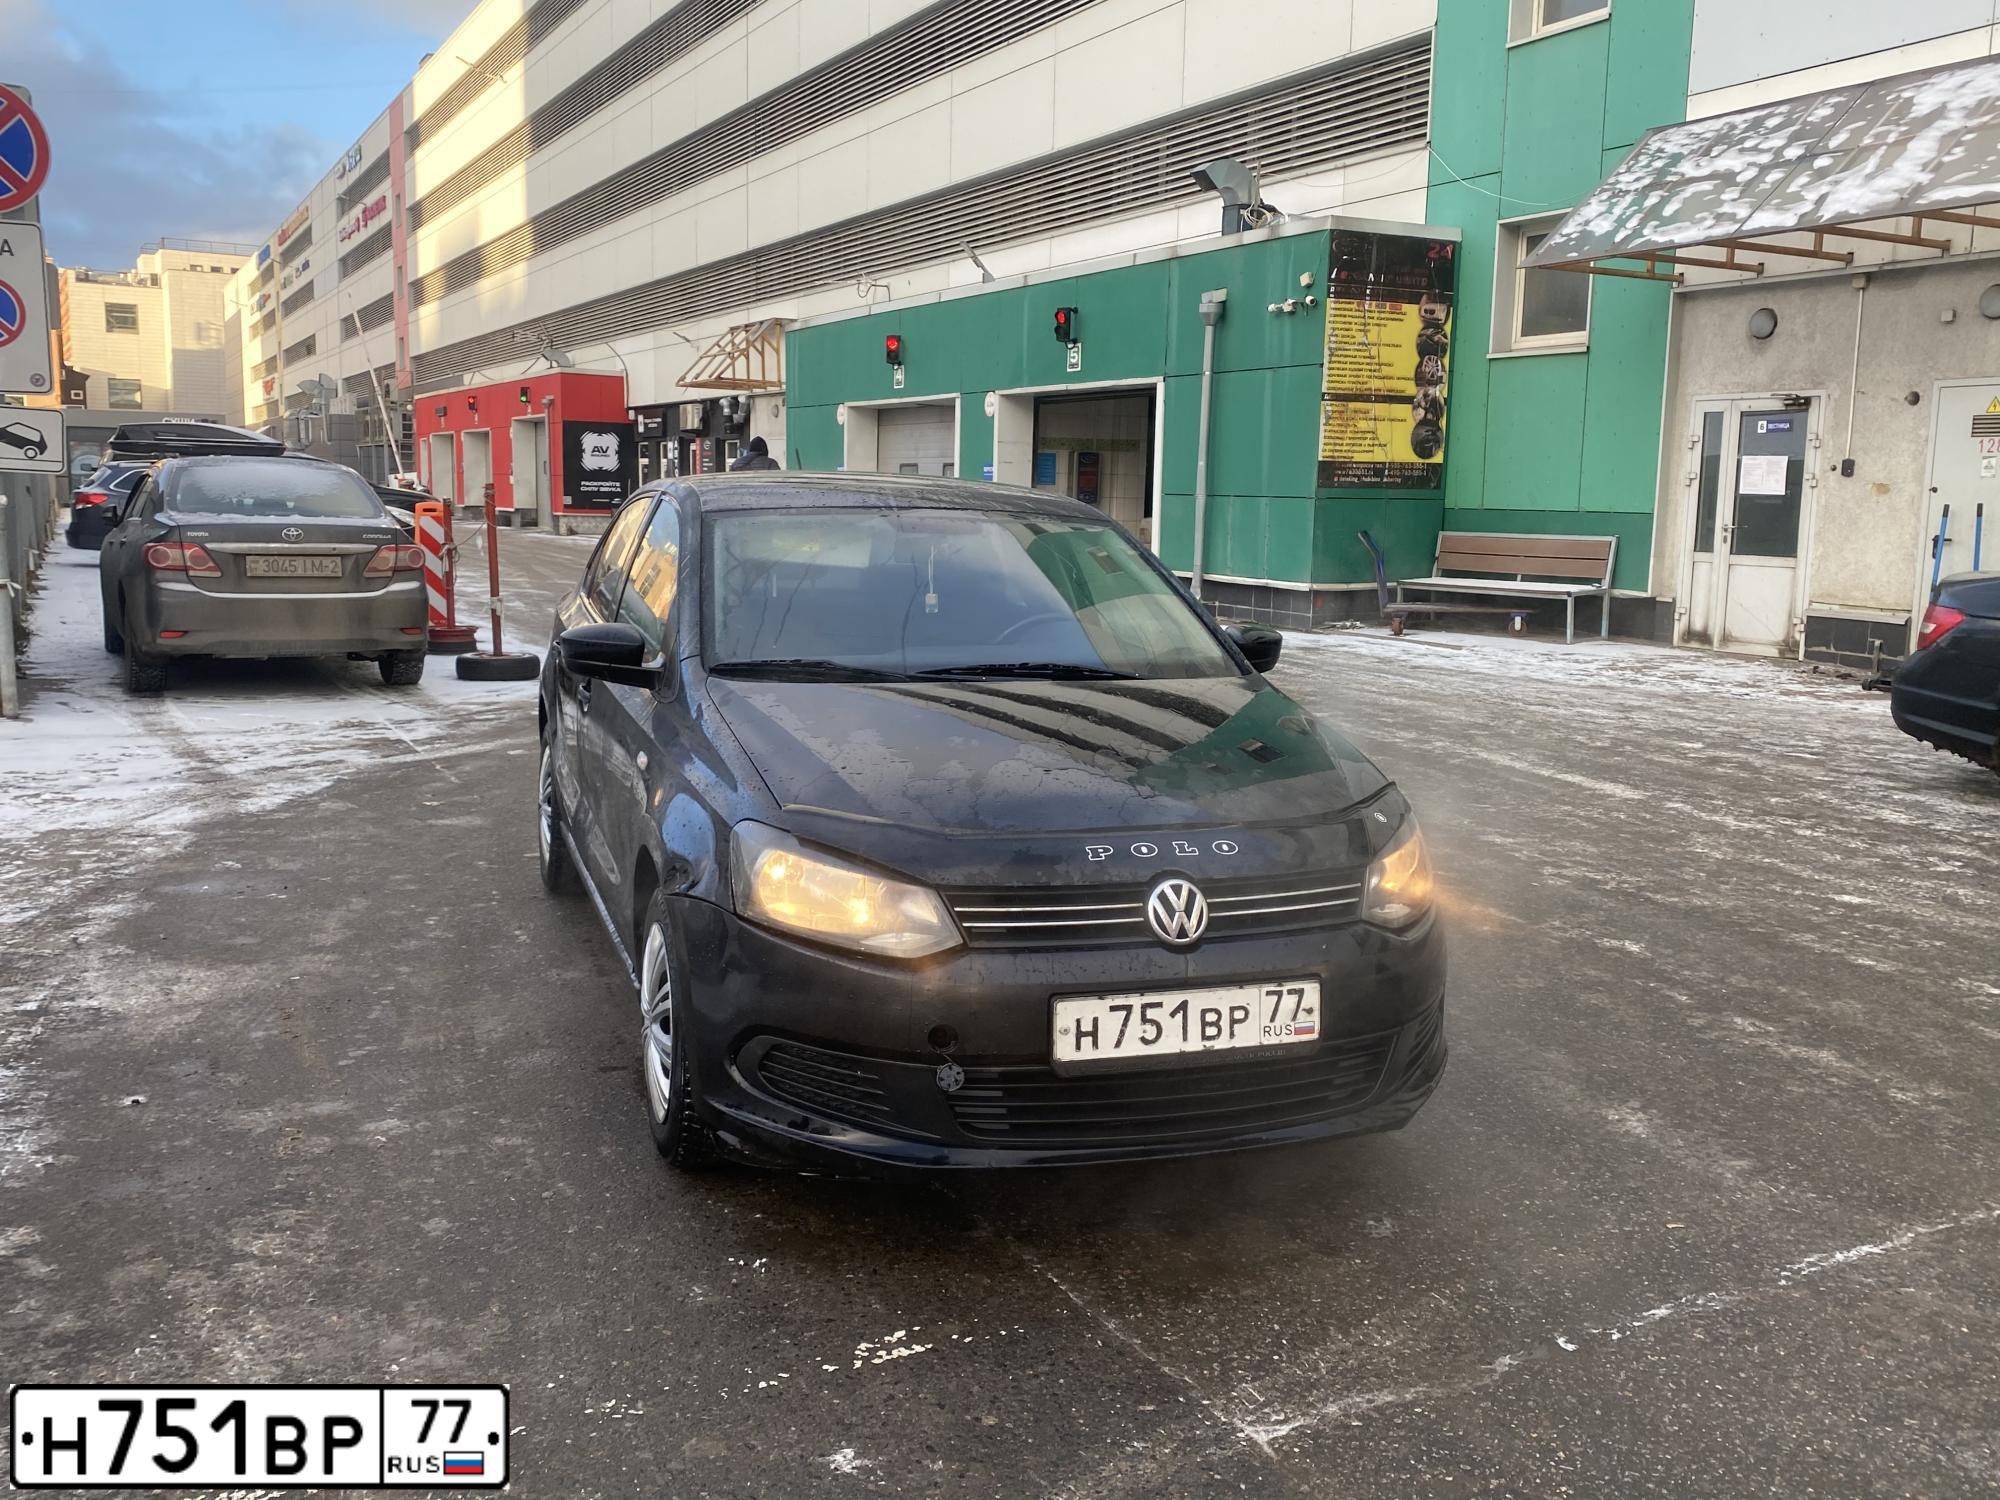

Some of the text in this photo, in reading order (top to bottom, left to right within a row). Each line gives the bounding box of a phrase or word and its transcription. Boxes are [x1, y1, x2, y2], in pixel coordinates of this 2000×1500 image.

[1426, 242, 1454, 262] 24
[1069, 346, 1079, 363] 5
[591, 445, 610, 454] AV
[262, 560, 297, 574] 3045
[1085, 840, 1239, 861] POLO
[1264, 987, 1305, 1023] 77
[1263, 1024, 1293, 1037] RUS
